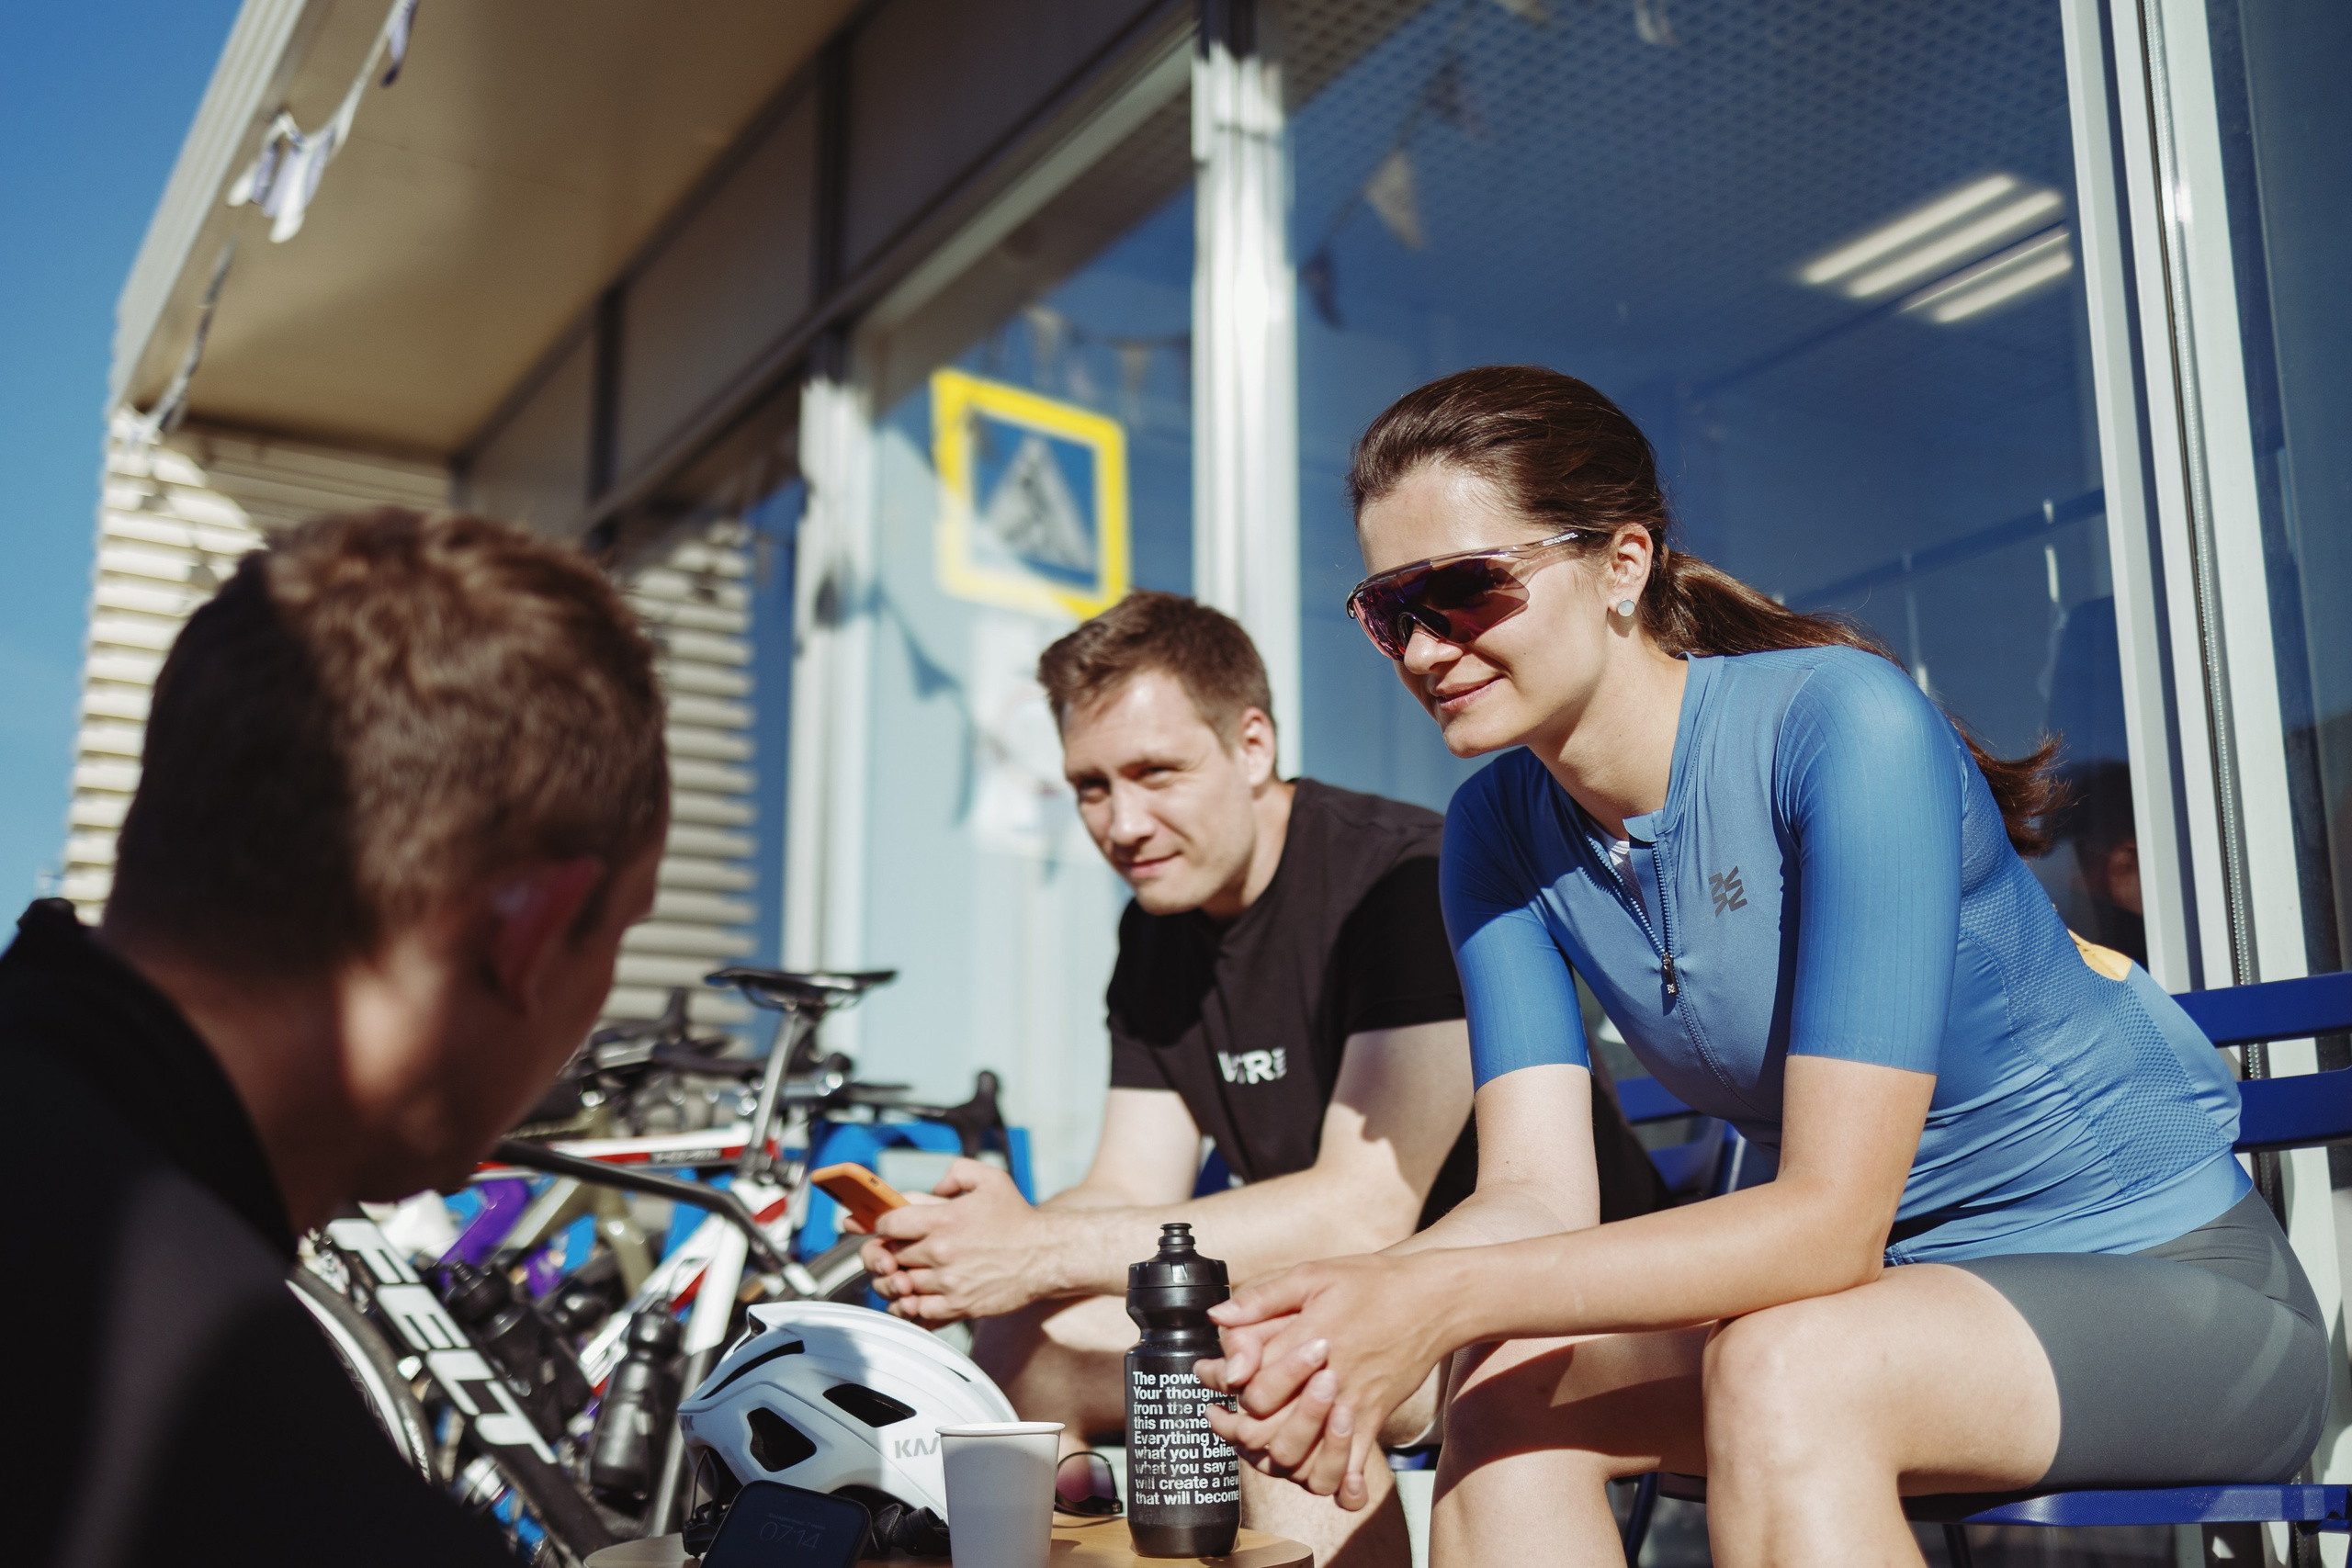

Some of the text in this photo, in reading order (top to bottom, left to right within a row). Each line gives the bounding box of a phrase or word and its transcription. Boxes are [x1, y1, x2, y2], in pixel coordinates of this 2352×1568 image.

[326, 1217, 558, 1464] FELT
[1133, 1371, 1201, 1388] The powe
[1133, 1386, 1162, 1400] Your
[1134, 1402, 1163, 1415] from
[1167, 1402, 1193, 1415] the
[1134, 1416, 1156, 1429] this
[1134, 1430, 1210, 1448] Everything
[895, 1437, 939, 1459] KAS
[1135, 1446, 1166, 1460] what
[1170, 1449, 1199, 1462] you
[1135, 1460, 1238, 1477] what you say an
[1136, 1476, 1155, 1489] will
[1159, 1476, 1208, 1490] create
[1212, 1477, 1220, 1488] a
[1136, 1491, 1159, 1505] that
[1163, 1491, 1190, 1505] will
